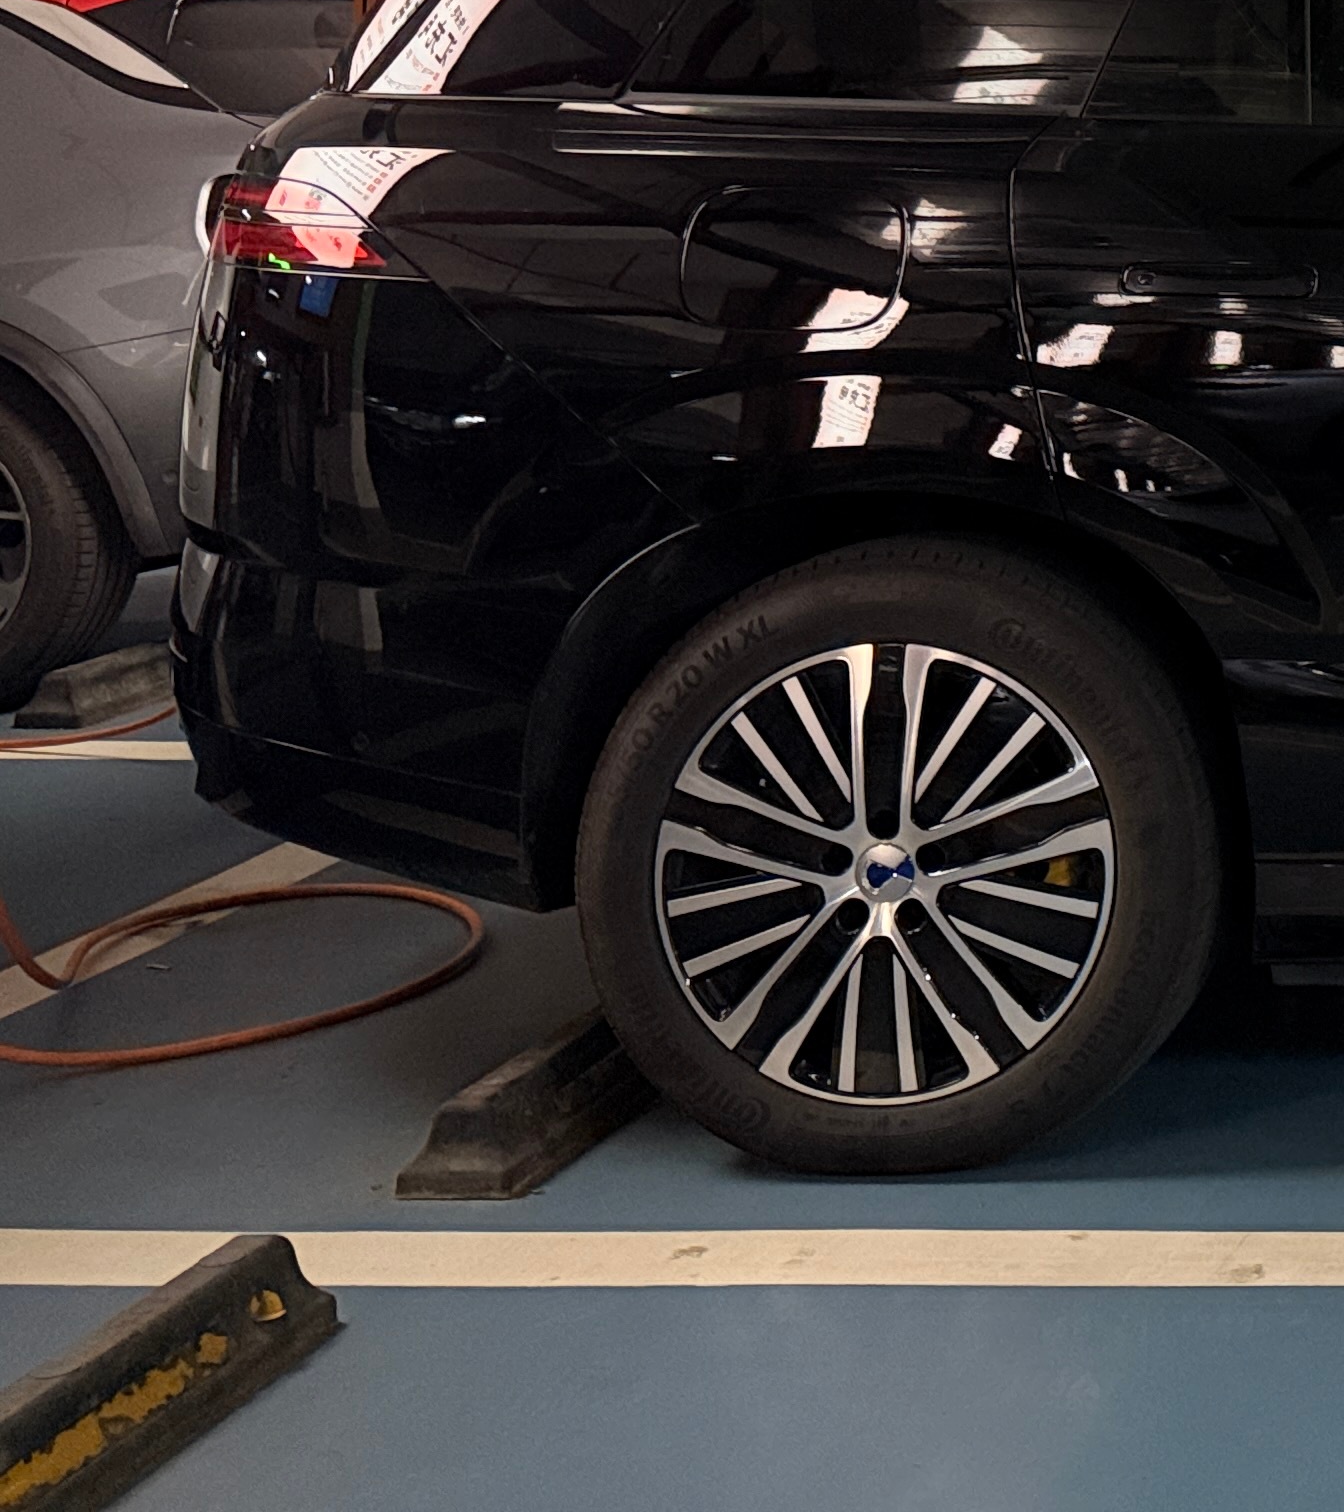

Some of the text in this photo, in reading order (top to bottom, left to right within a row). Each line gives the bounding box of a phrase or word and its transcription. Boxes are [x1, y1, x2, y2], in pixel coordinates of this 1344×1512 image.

[666, 664, 702, 702] 20
[702, 636, 732, 669] W
[743, 613, 779, 651] XL
